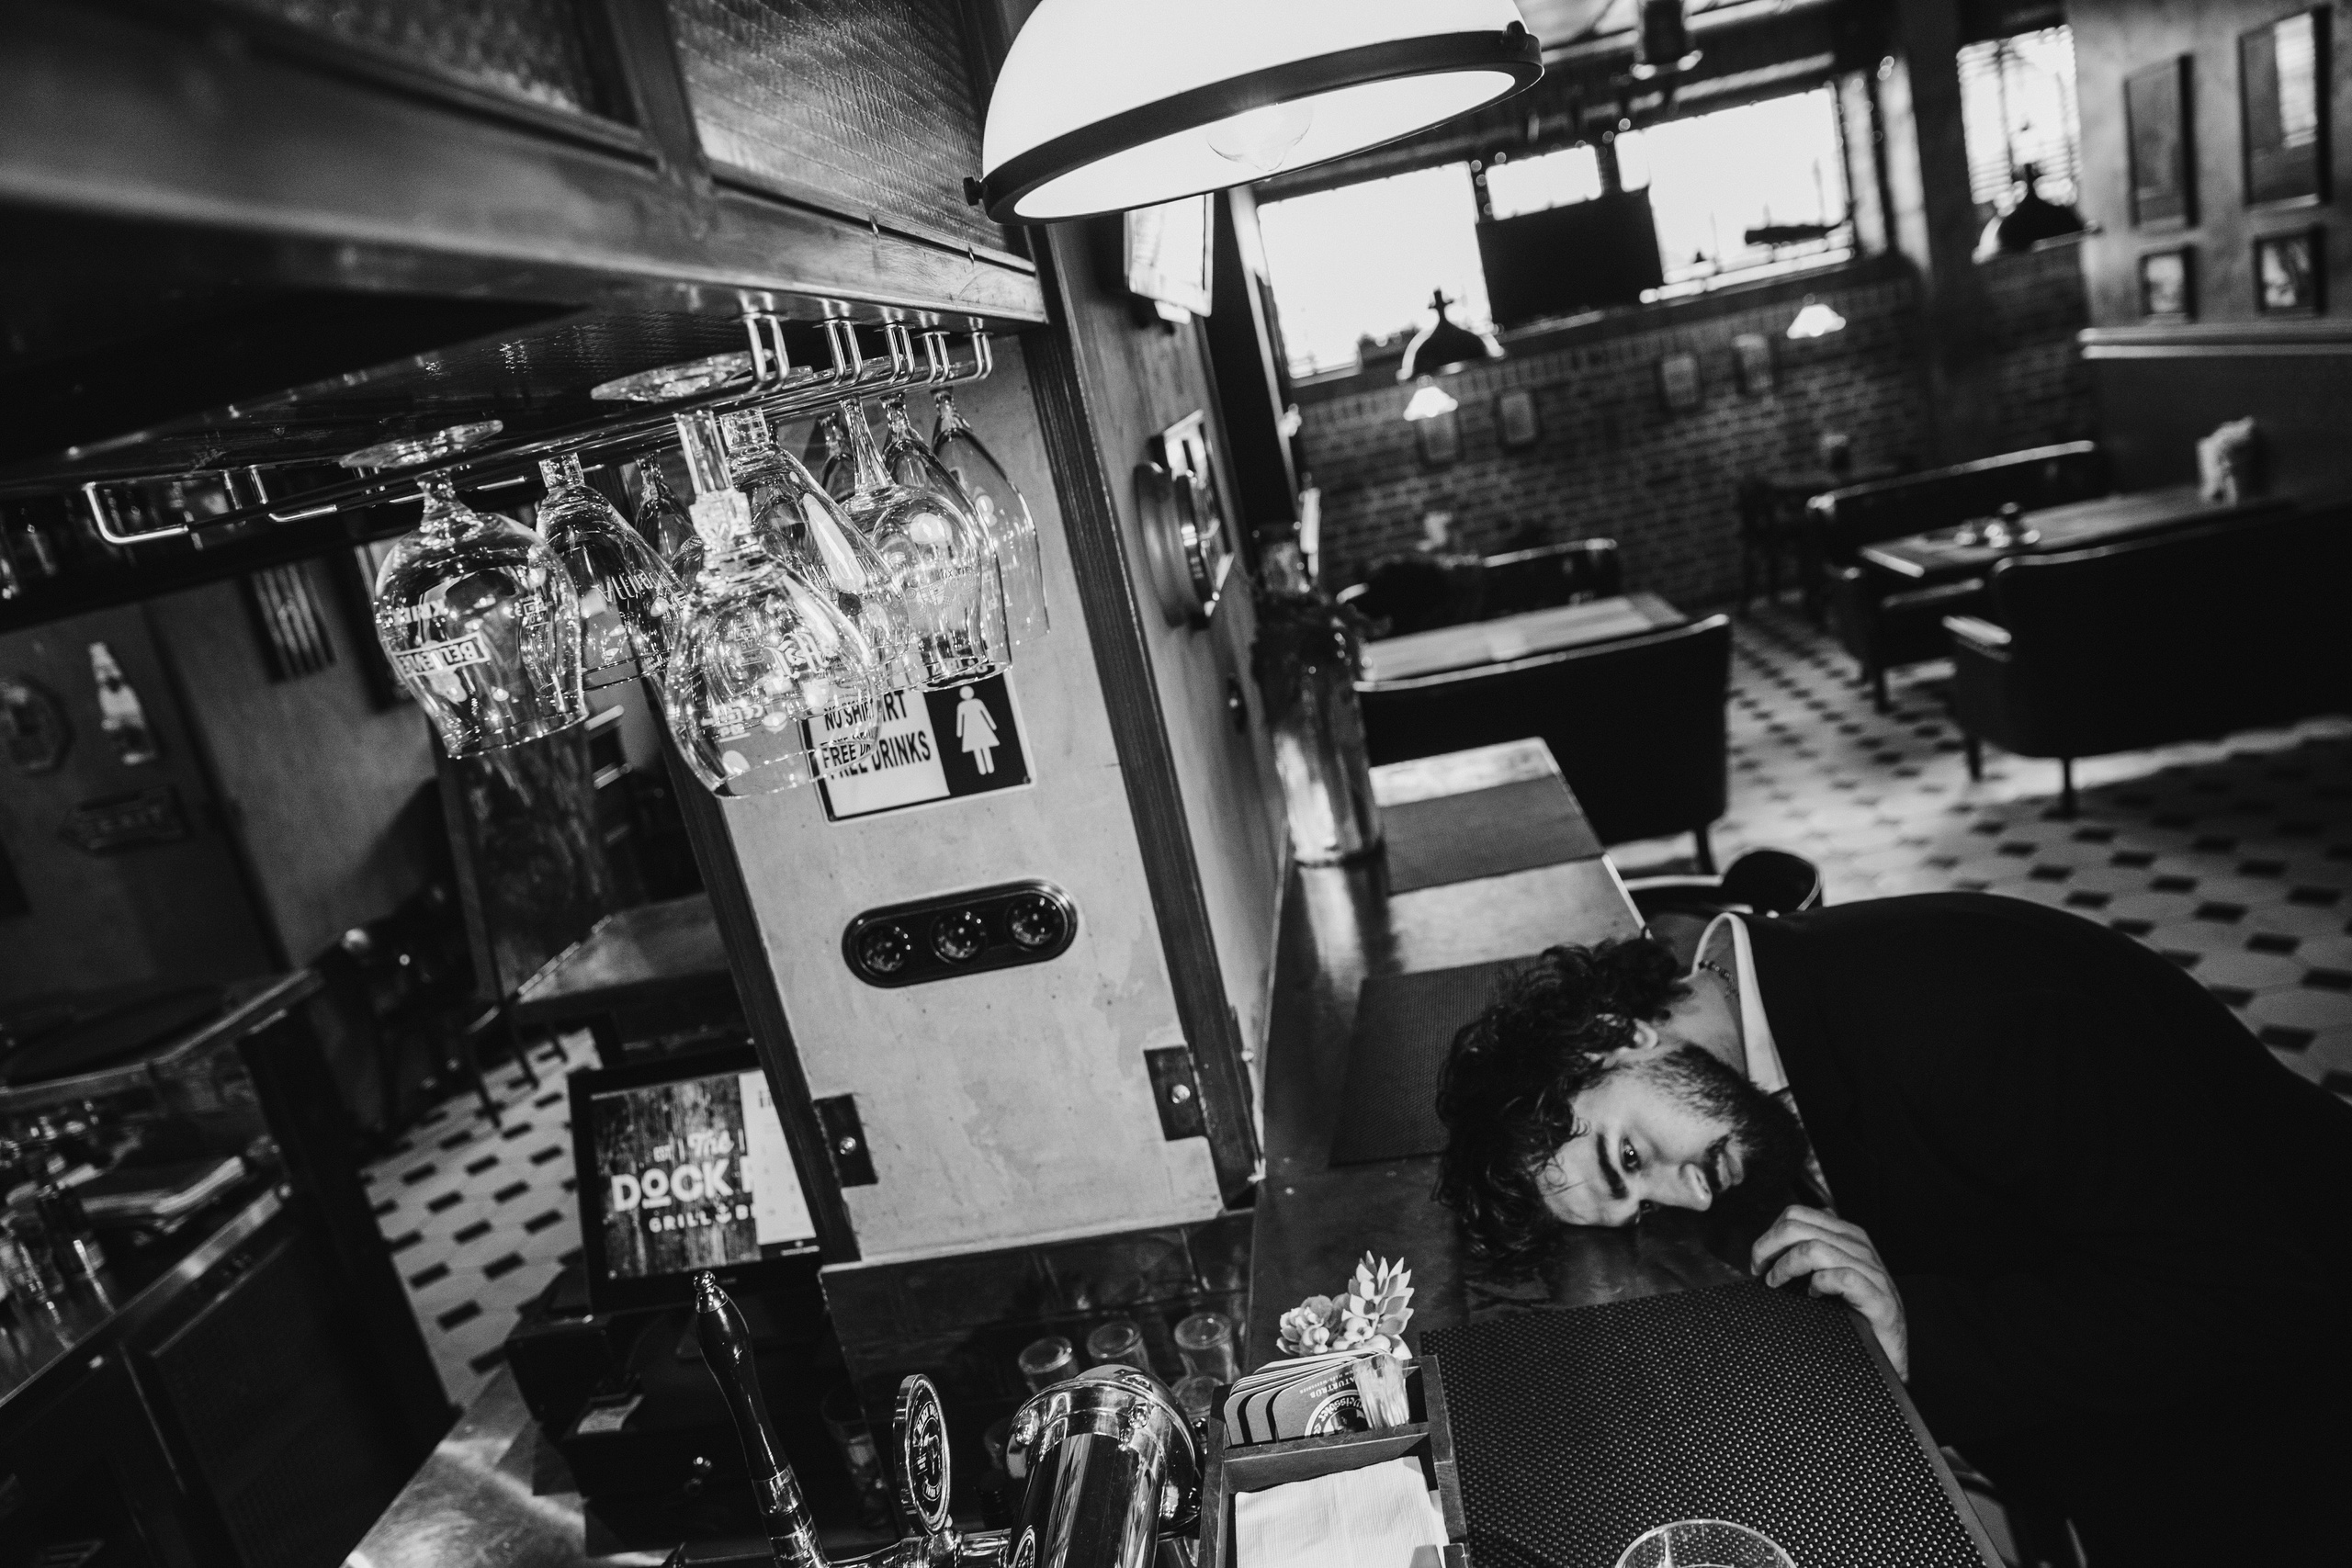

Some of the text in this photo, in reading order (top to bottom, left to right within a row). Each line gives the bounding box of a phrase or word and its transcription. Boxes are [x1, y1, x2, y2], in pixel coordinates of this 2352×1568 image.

[871, 729, 932, 772] DRINKS
[649, 1210, 712, 1233] GRILL
[1309, 1377, 1356, 1399] ATURTRÜB
